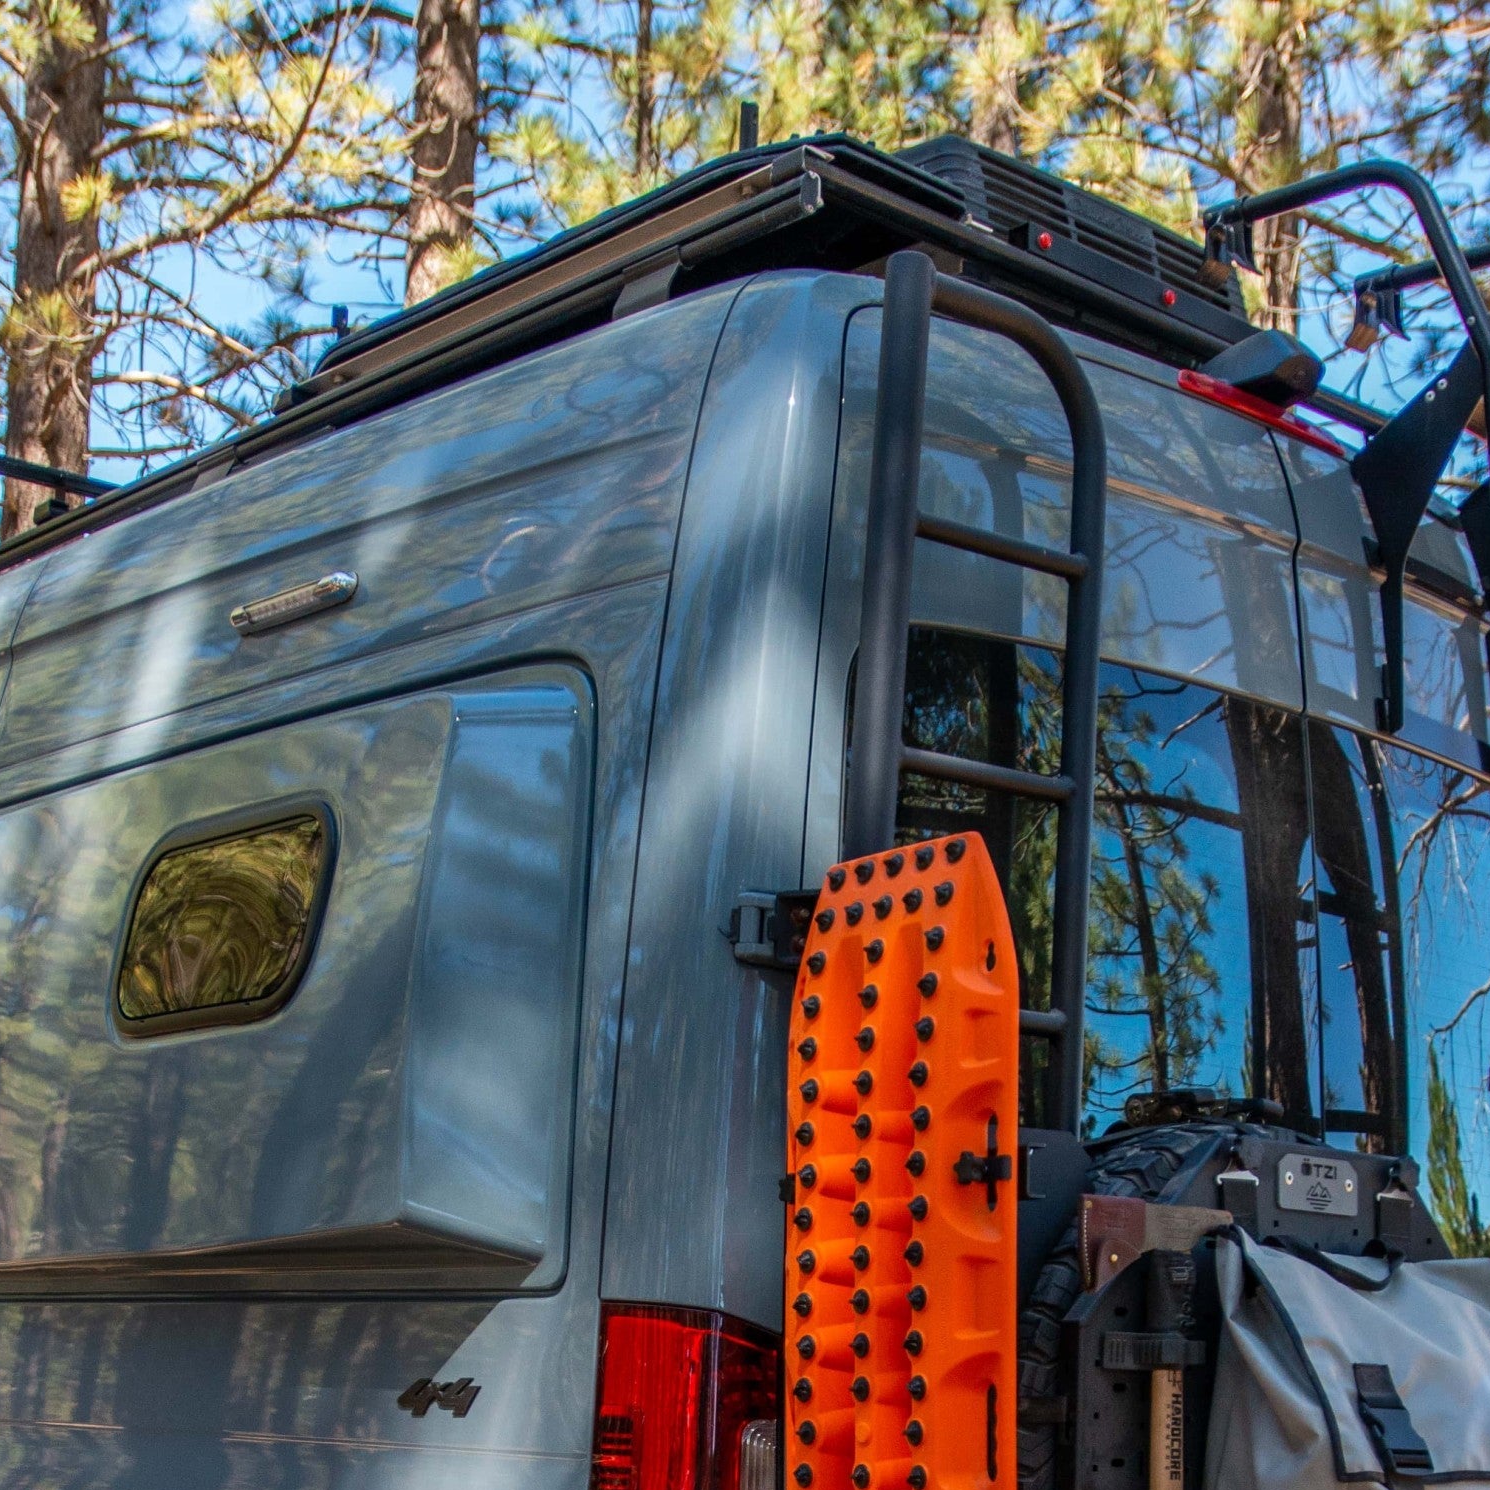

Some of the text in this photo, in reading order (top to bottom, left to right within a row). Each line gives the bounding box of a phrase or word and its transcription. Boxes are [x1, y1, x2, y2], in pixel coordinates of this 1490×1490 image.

[1301, 1158, 1337, 1180] ÖTZI
[396, 1377, 482, 1418] 4x4
[1170, 1393, 1183, 1481] HARDCORE
